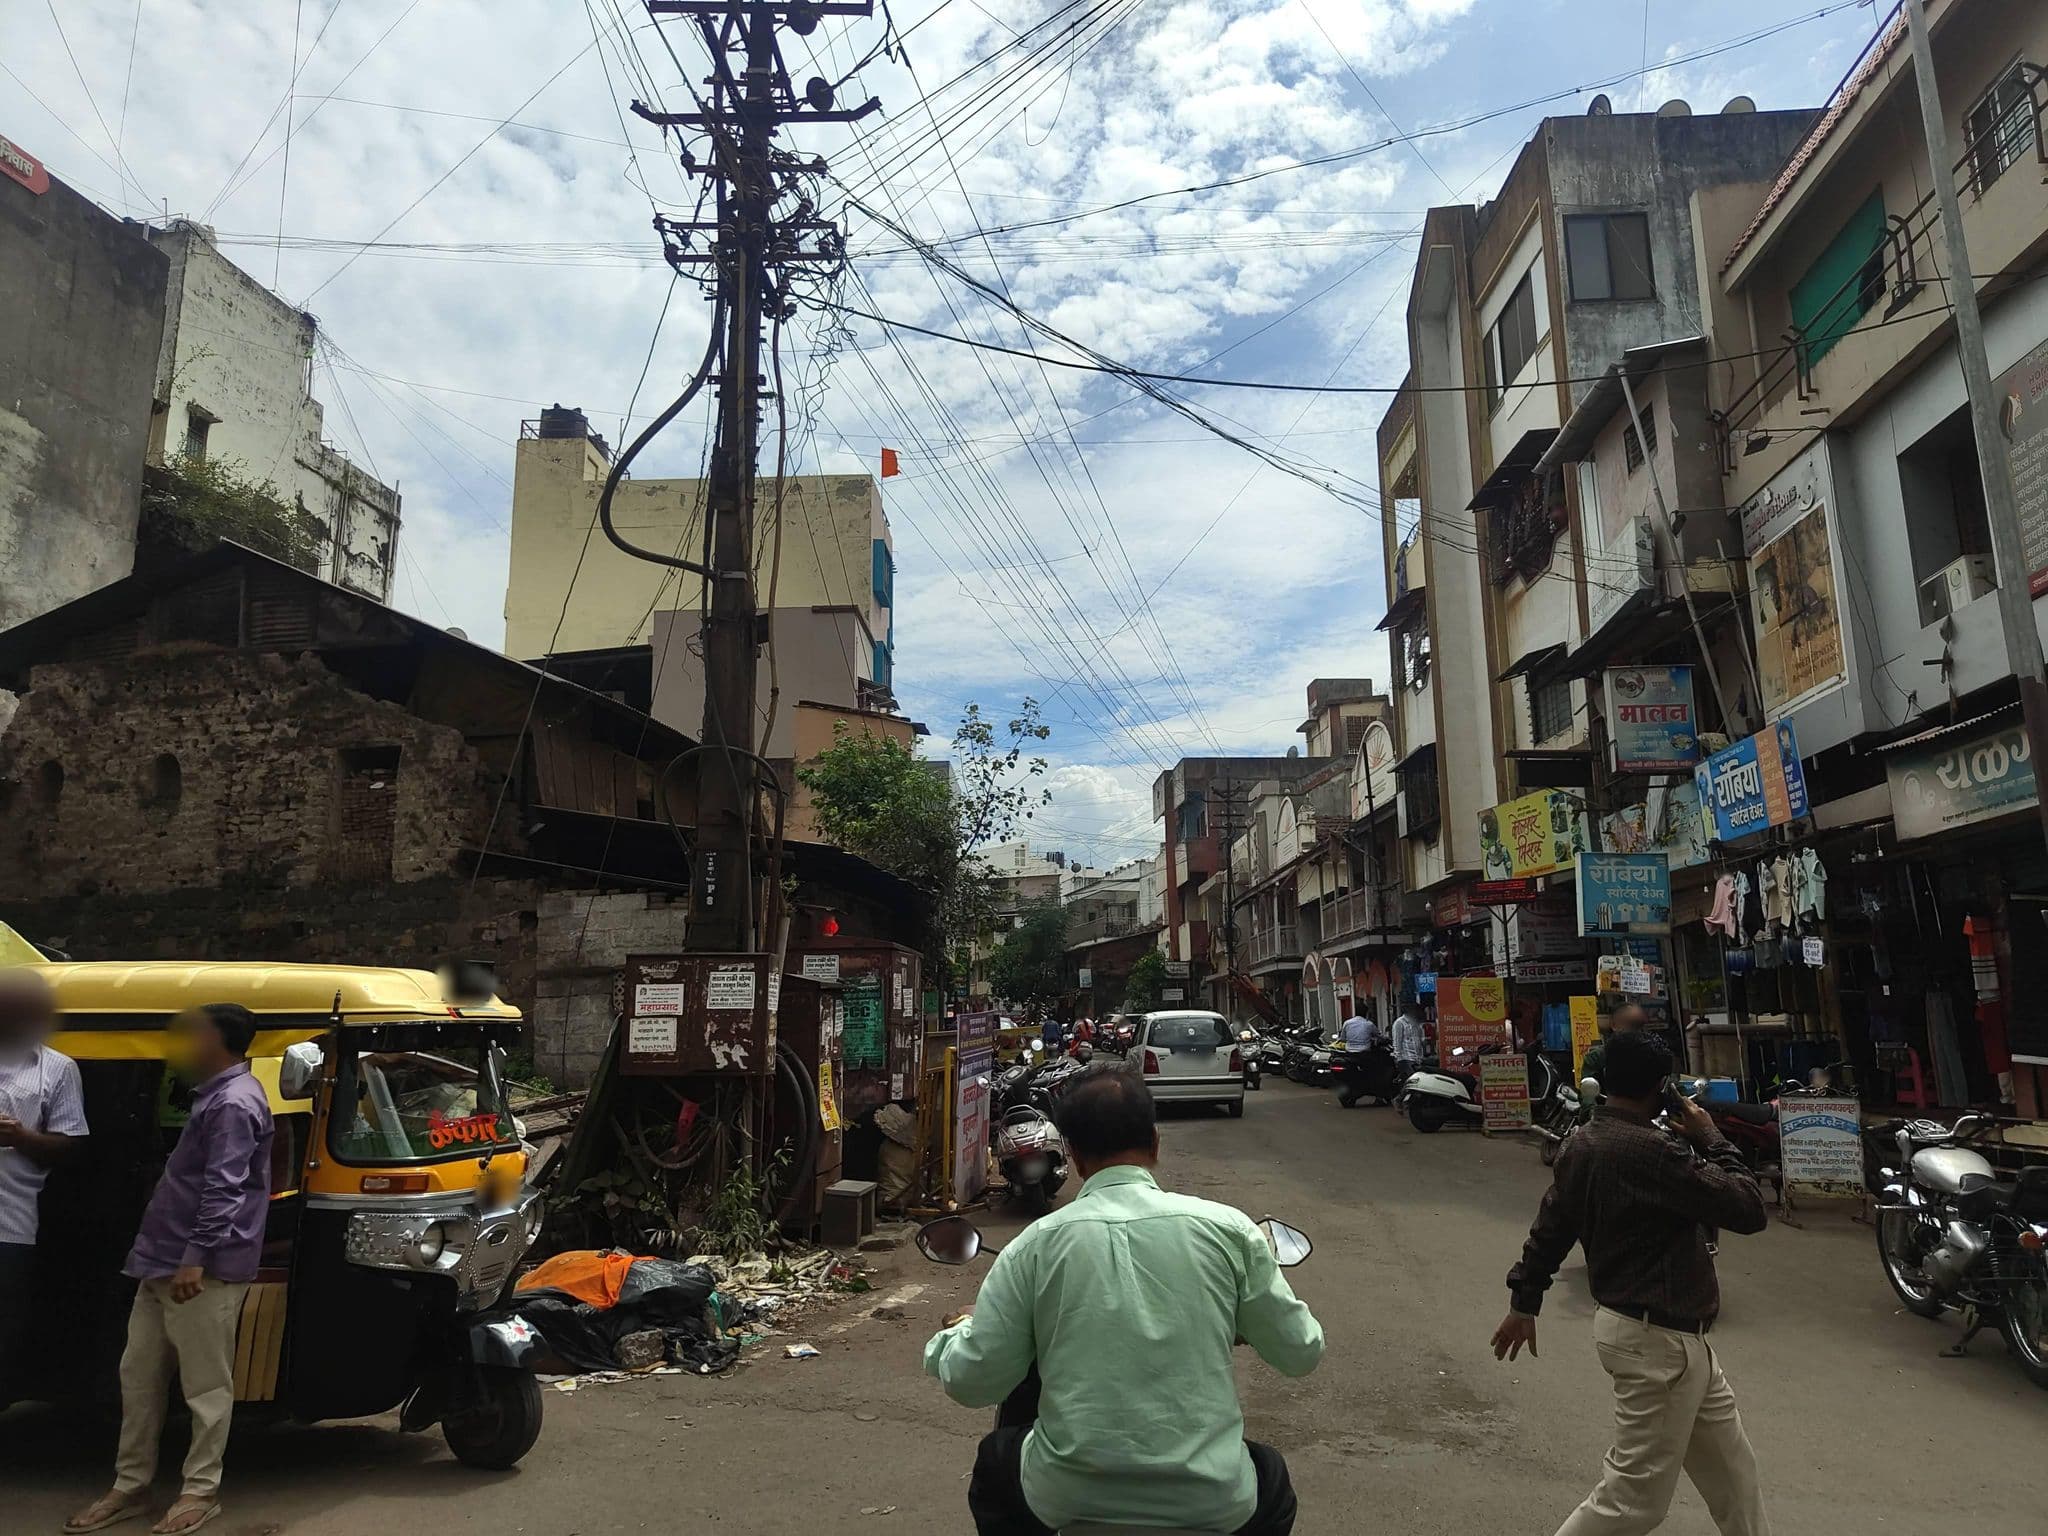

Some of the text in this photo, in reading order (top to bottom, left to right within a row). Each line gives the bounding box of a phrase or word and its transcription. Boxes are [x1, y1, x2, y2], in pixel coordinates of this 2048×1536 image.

[1618, 704, 1688, 723] मालन
[1713, 758, 1760, 808] रॉबिया
[1588, 857, 1657, 884] रॉबिया
[1642, 885, 1665, 899] वेअर
[640, 1003, 679, 1011] महाप्रसाद
